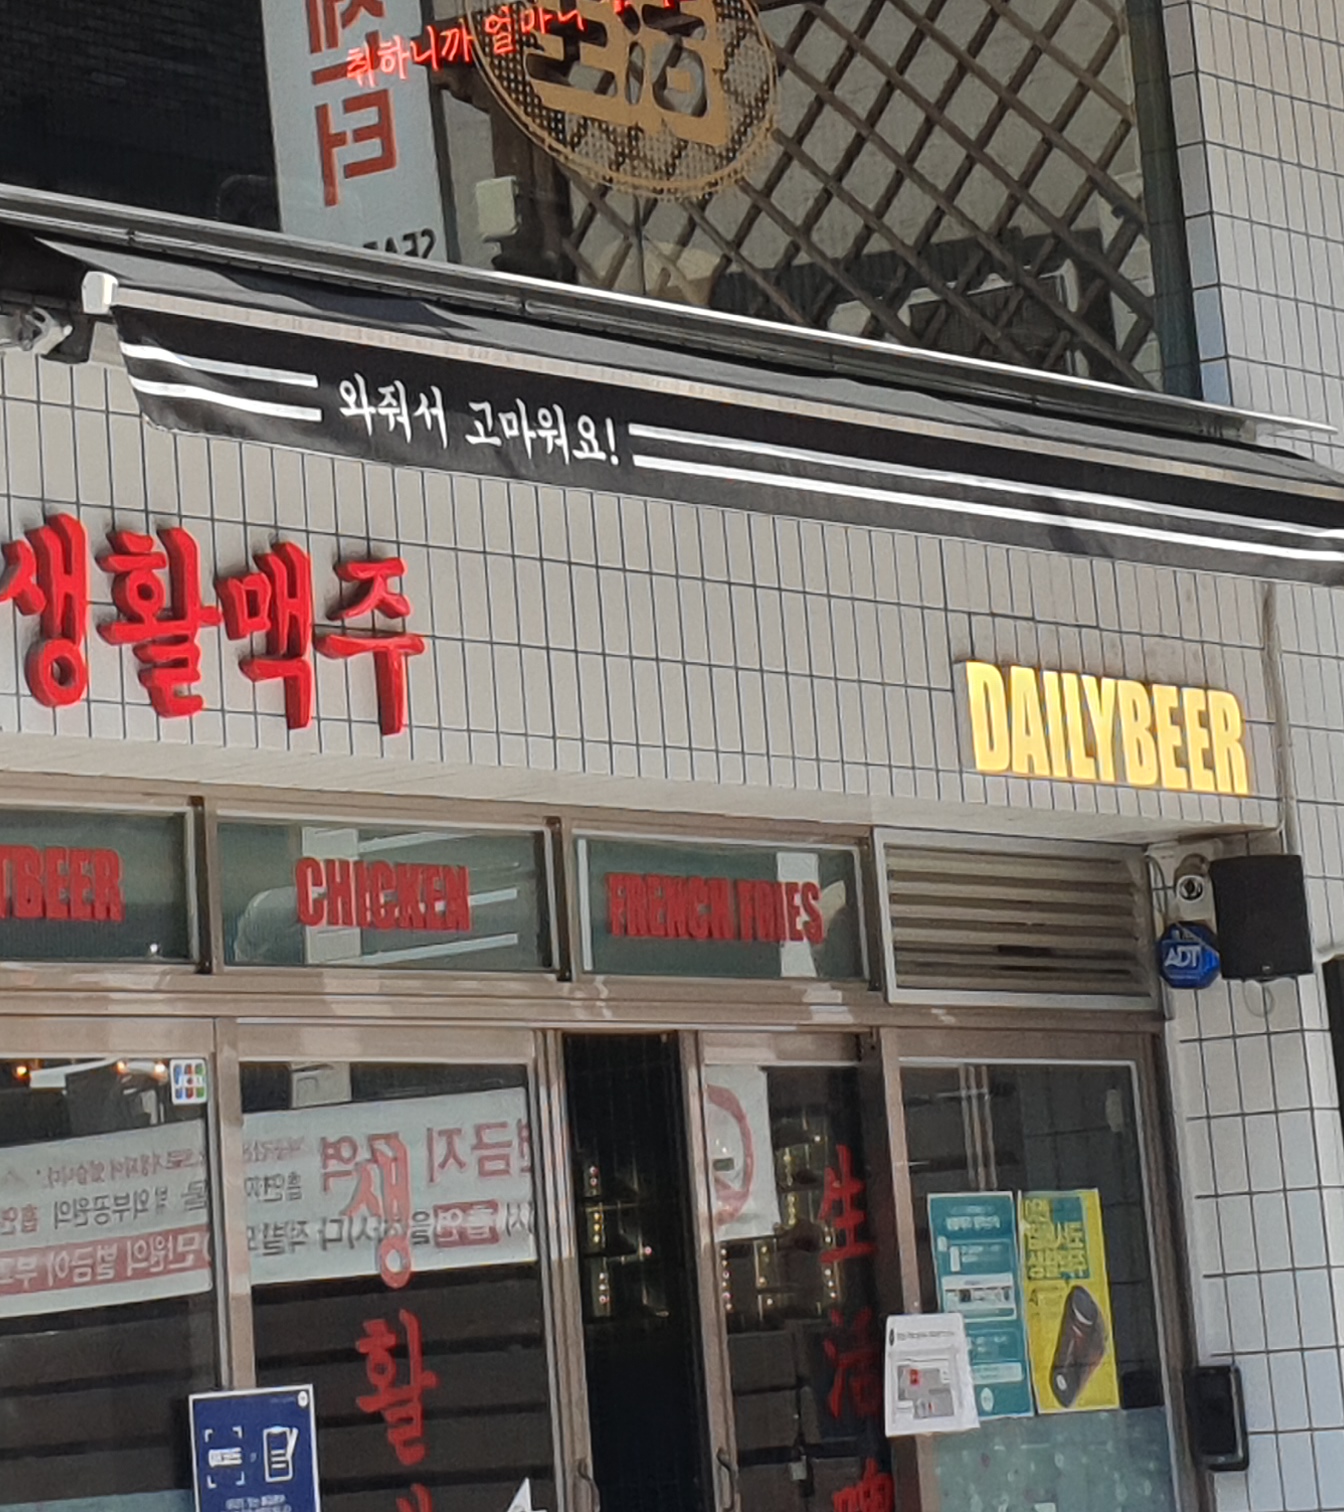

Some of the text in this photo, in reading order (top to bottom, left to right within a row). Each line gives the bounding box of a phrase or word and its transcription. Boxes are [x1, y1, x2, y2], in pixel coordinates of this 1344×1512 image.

[346, 14, 474, 88] 취하니까
[339, 373, 619, 466] 와줘서 고마워요!
[965, 660, 1249, 795] DAILYBEER
[293, 856, 471, 932] CHICKEN
[606, 873, 826, 944] FRENCH FRIES
[1165, 945, 1201, 967] ADT
[340, 1132, 439, 1512] 생활
